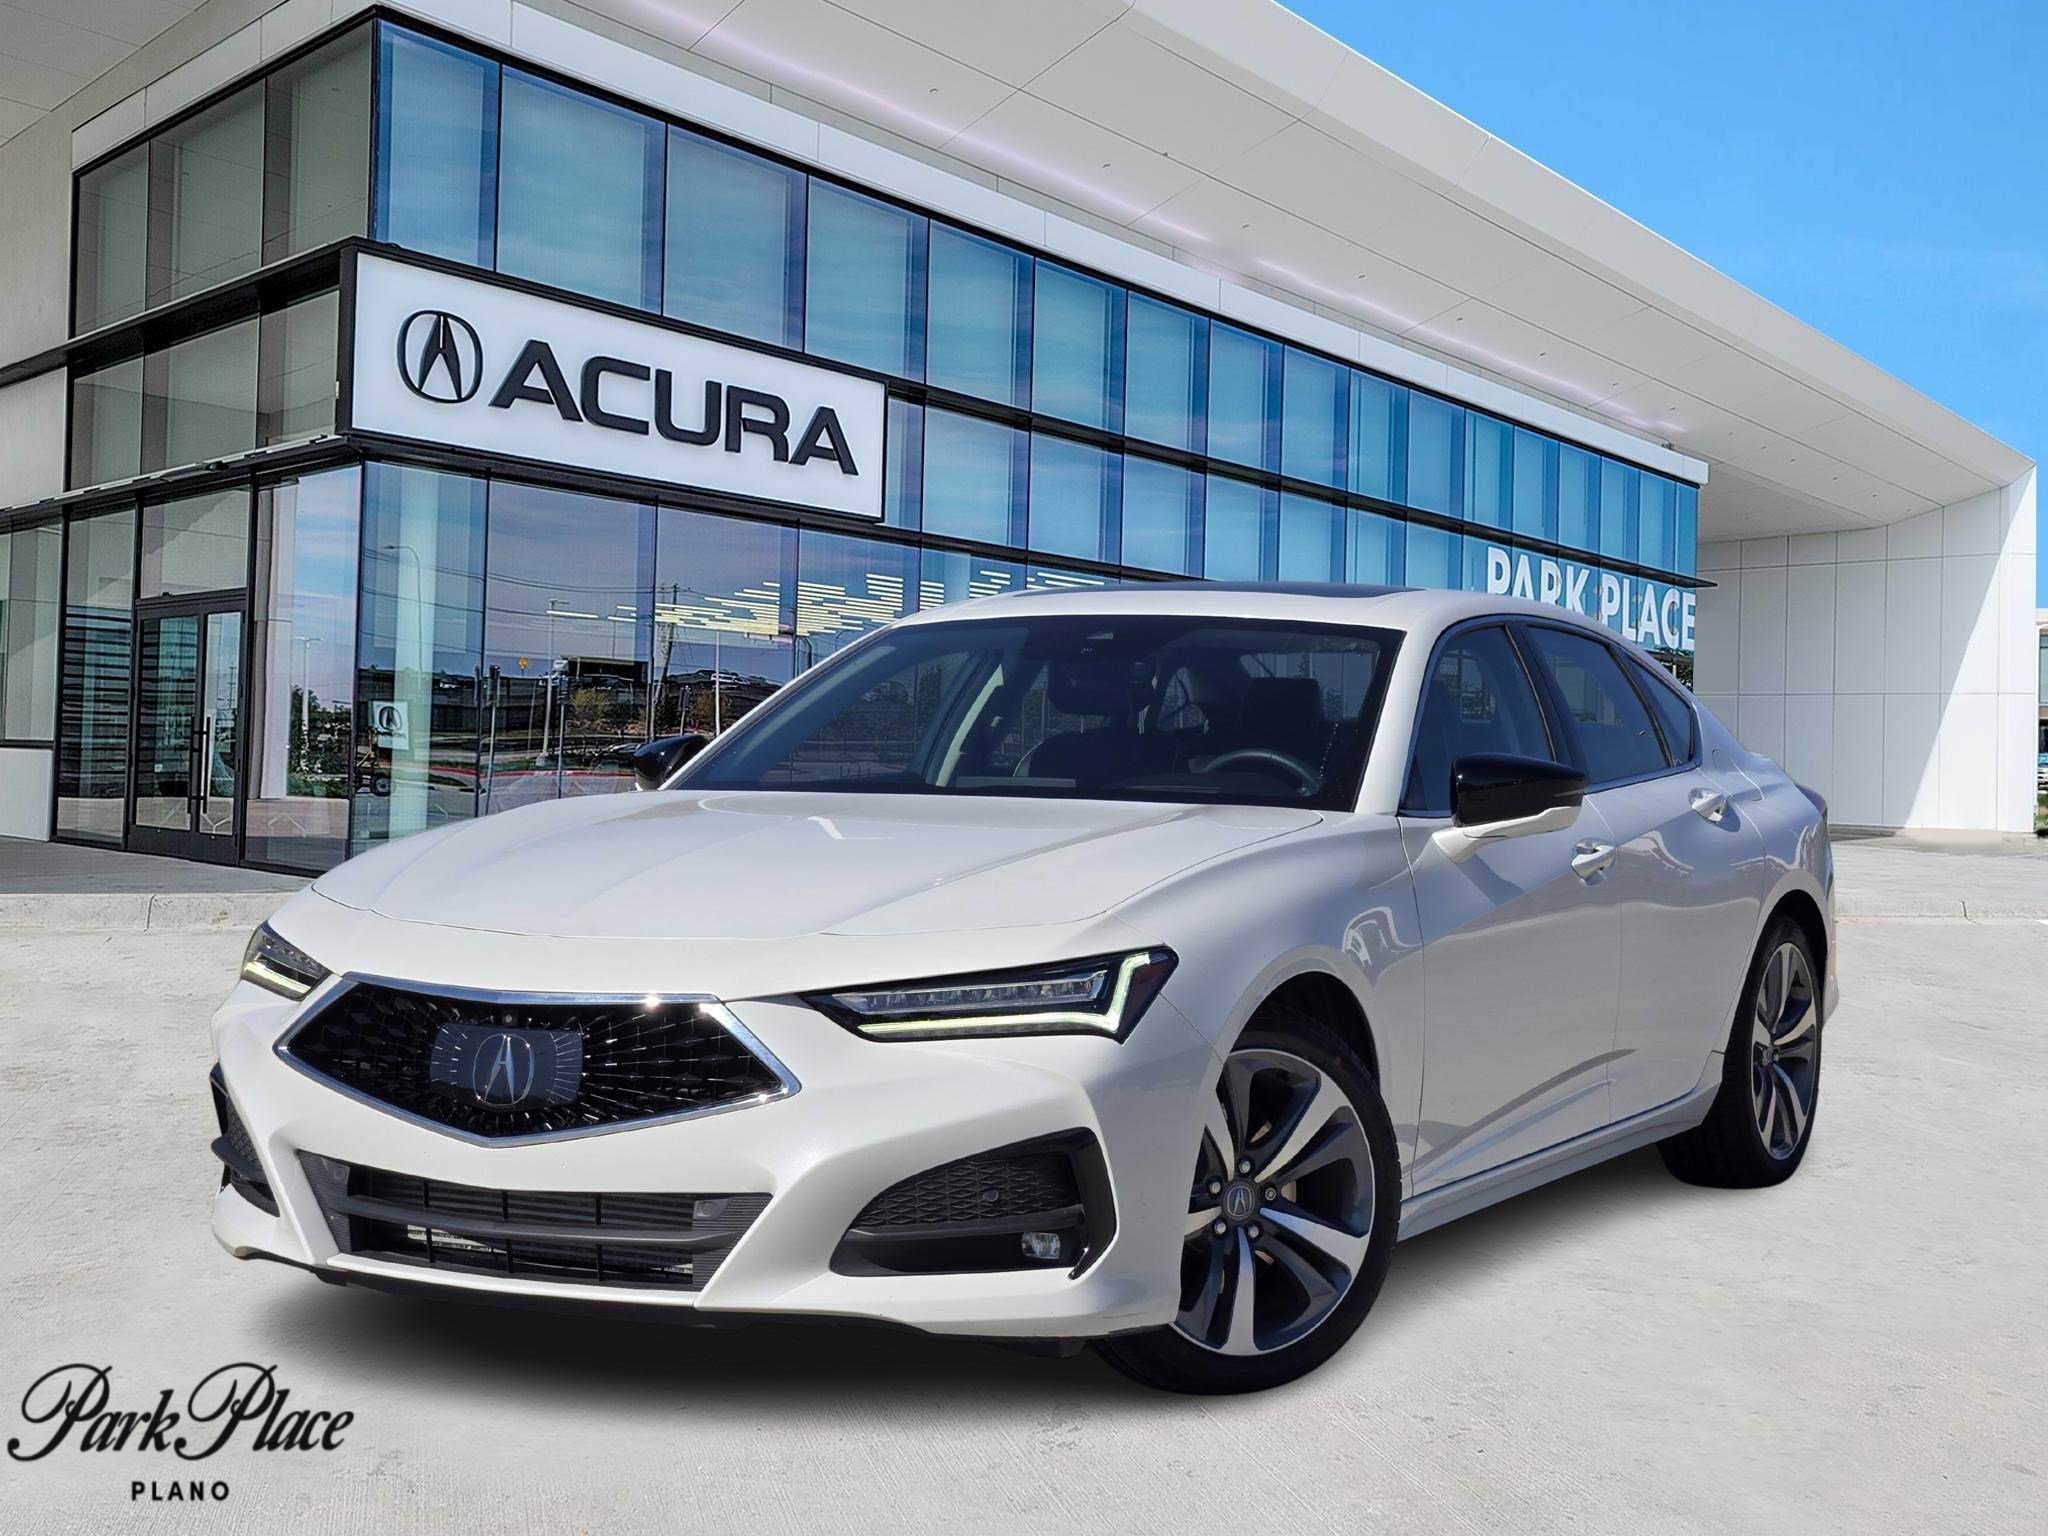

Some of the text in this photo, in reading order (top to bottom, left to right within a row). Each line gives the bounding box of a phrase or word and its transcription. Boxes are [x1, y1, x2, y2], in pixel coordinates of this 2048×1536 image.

[488, 339, 859, 476] ACURA
[1487, 547, 1696, 650] PARK PLACE
